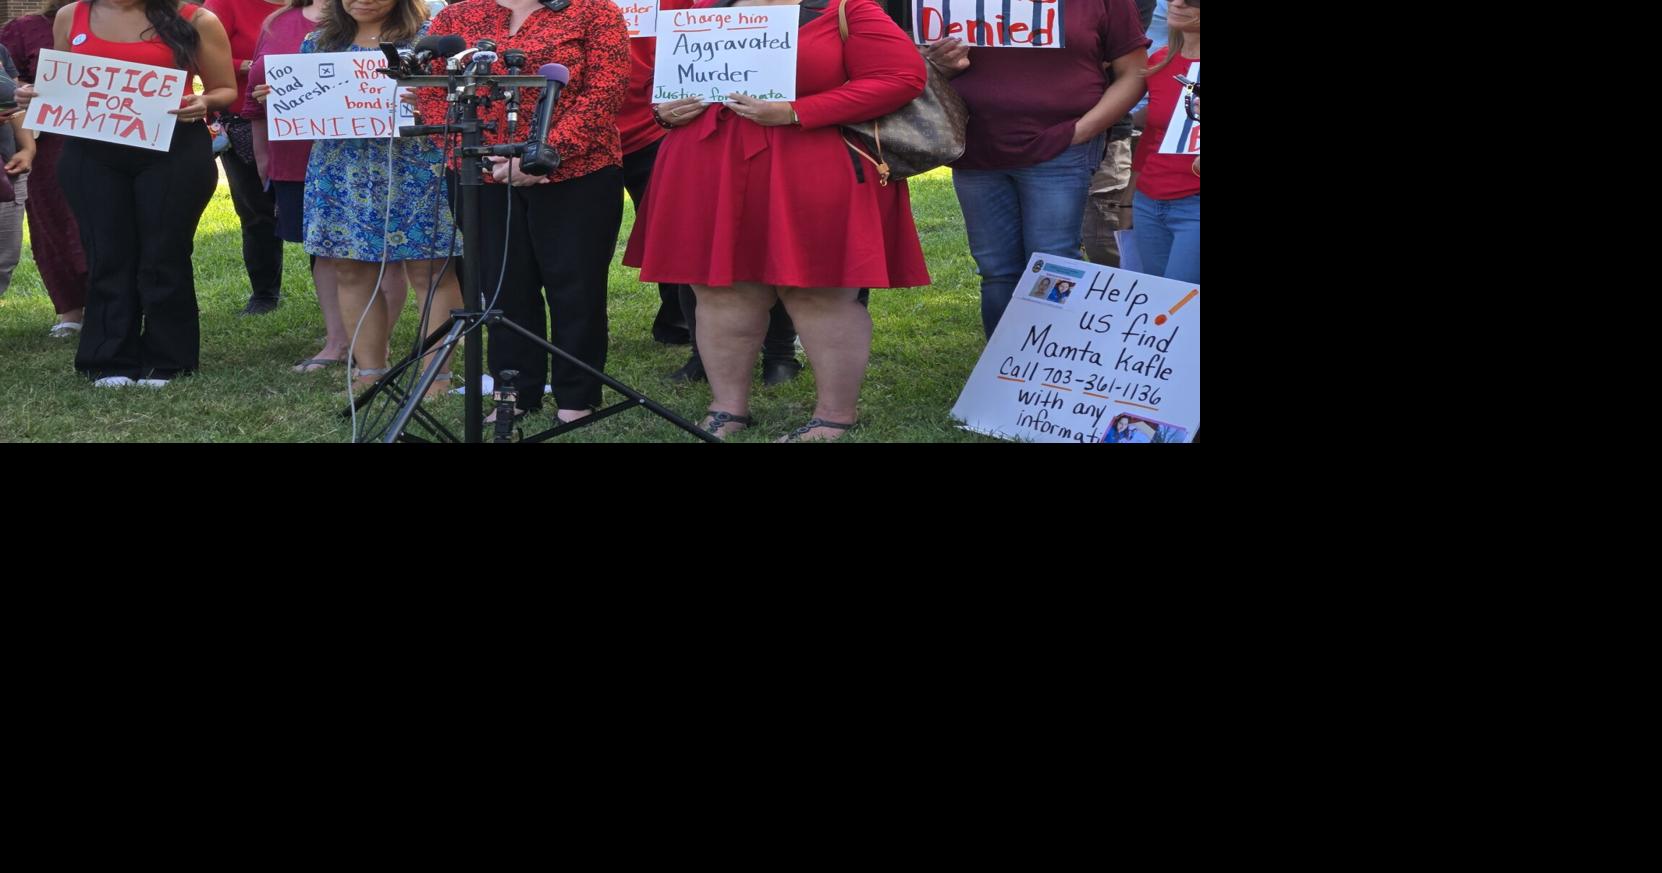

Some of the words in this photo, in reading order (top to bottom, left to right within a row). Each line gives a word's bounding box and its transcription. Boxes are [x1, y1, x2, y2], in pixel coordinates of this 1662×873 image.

[673, 11, 732, 29] Charge
[738, 12, 769, 24] him
[921, 7, 1055, 46] Denied
[672, 31, 792, 62] Aggravated
[43, 59, 178, 98] JUSTICE
[267, 65, 293, 81] Too
[270, 76, 304, 96] bad
[677, 62, 758, 84] Murder
[359, 82, 386, 94] for
[709, 87, 729, 101] for
[86, 92, 141, 115] FOR
[344, 95, 382, 109] bond
[274, 117, 394, 137] DENIED!
[1084, 271, 1149, 317] Help
[1020, 324, 1103, 367] Mamta
[1079, 311, 1114, 333] us
[1122, 313, 1179, 354] find
[999, 356, 1039, 381] Call
[1043, 367, 1162, 406] 703-361-1136
[1018, 387, 1064, 410] with
[1072, 402, 1107, 428] any
[1016, 408, 1102, 443] informati
